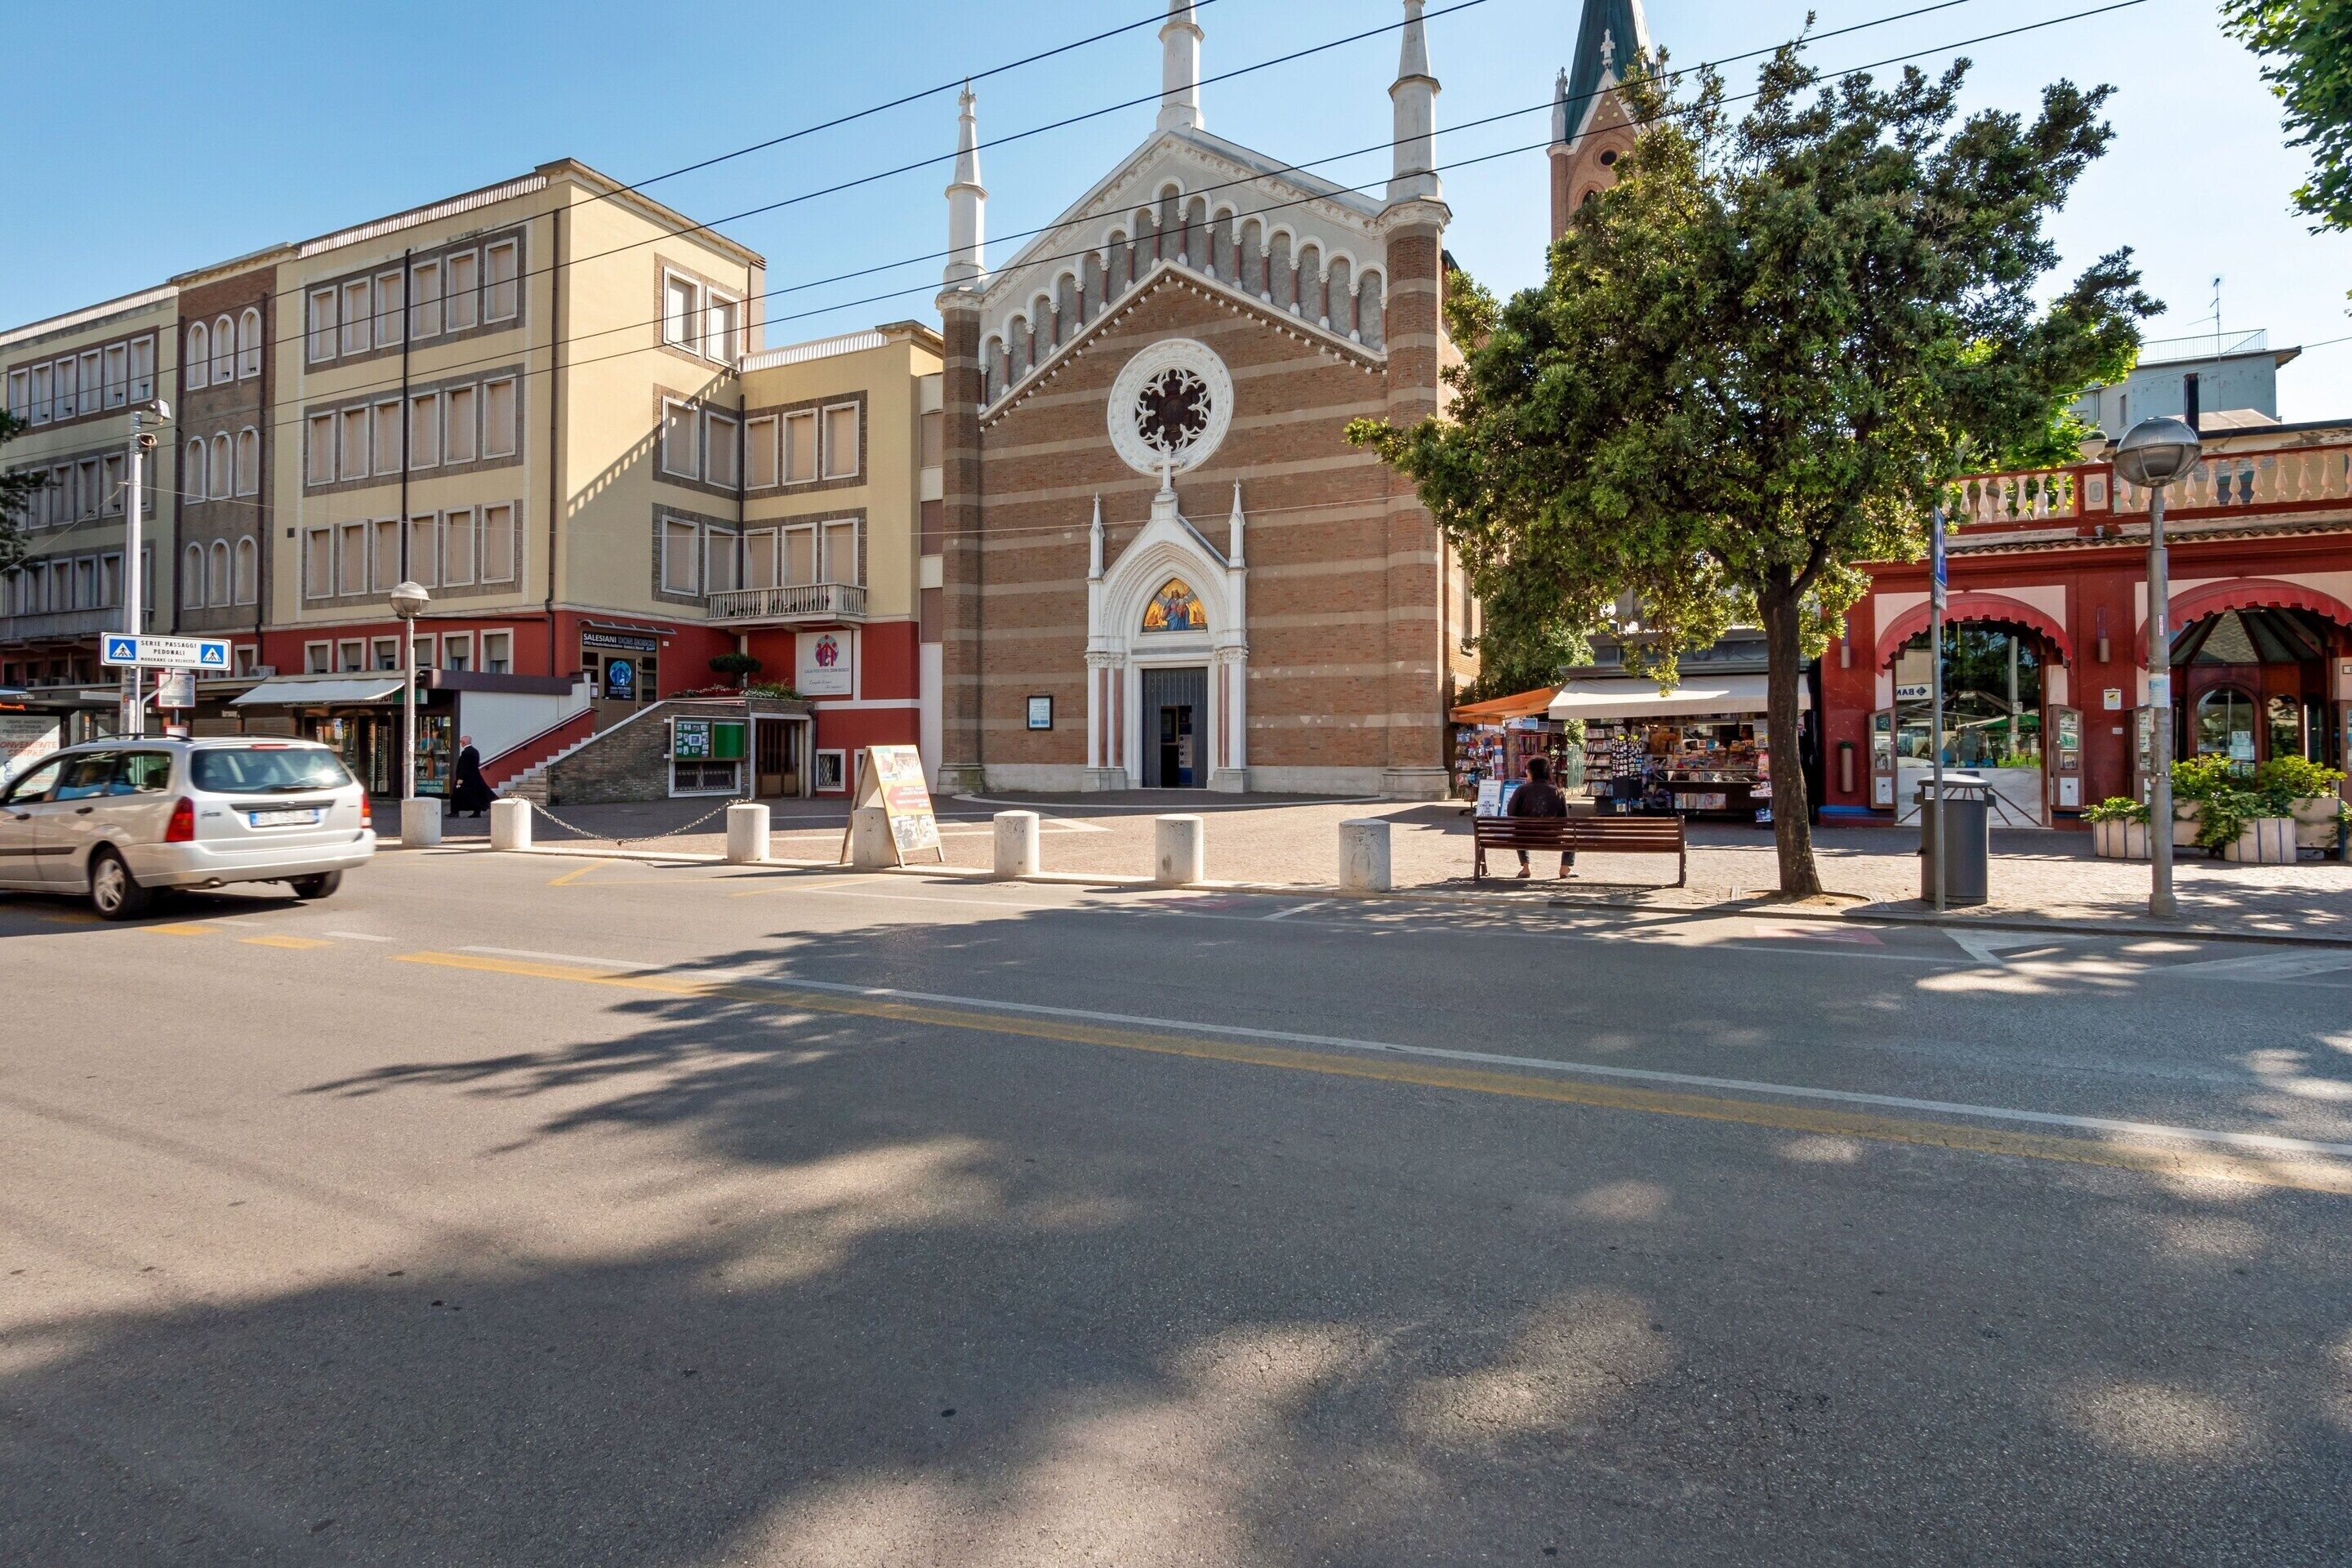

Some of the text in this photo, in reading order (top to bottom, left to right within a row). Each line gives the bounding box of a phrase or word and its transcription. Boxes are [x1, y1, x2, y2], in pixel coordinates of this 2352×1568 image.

[583, 633, 617, 644] SALESIANI
[617, 636, 634, 645] DON
[634, 638, 656, 647] BOSCO
[0, 741, 58, 749] ONVENIENTE
[7, 749, 46, 757] SEMPRE
